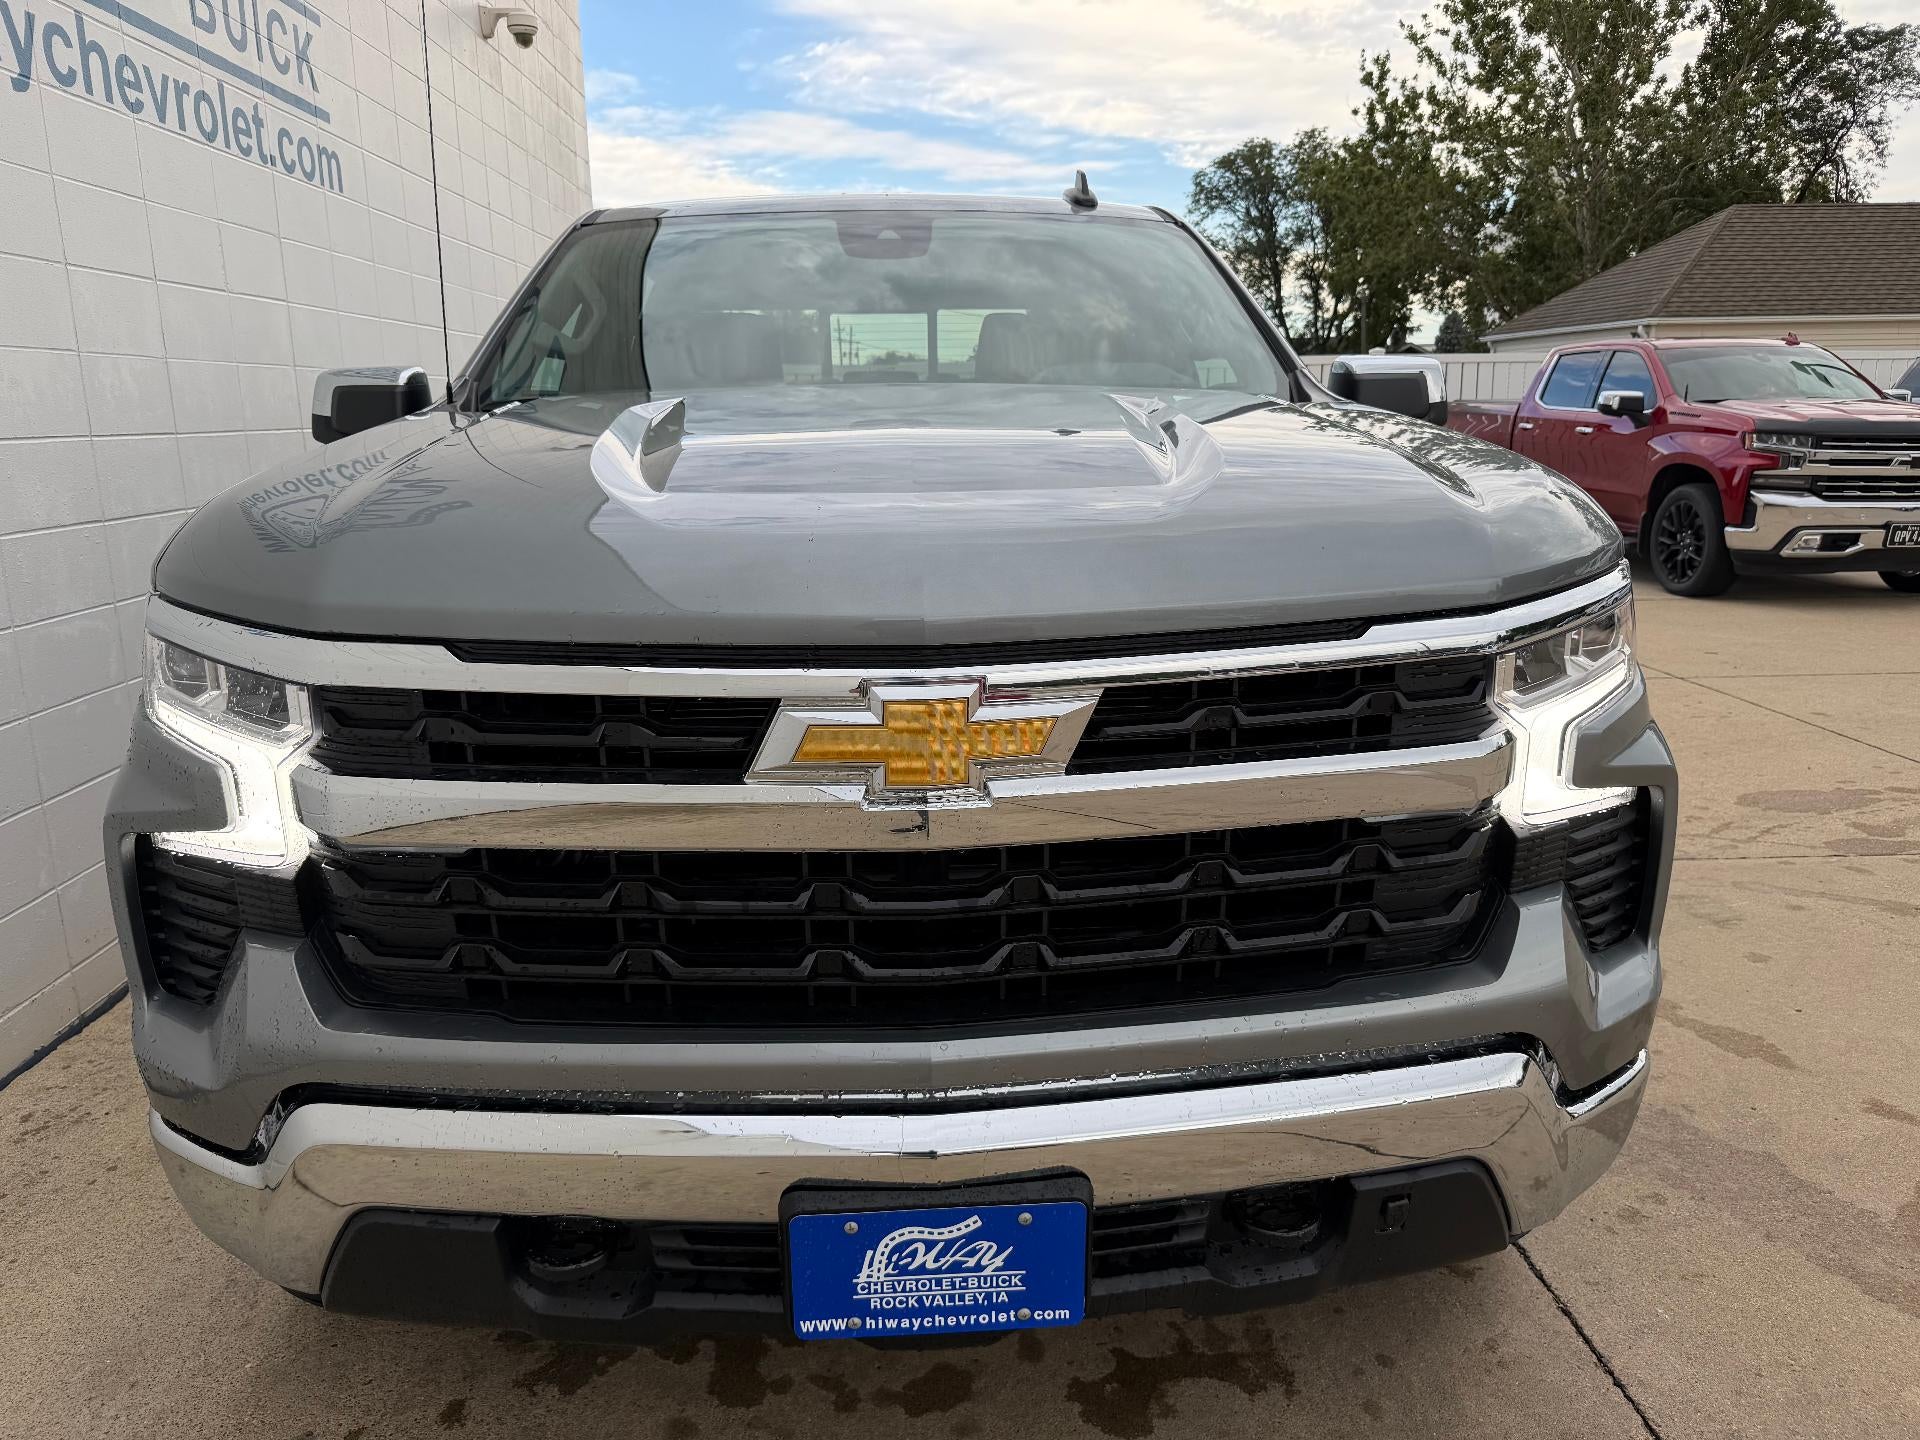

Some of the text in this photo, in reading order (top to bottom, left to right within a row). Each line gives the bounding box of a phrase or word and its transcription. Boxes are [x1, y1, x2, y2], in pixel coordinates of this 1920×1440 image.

[0, 0, 344, 193] ychevrolet.com
[856, 1275, 1023, 1295] CHEVROLET-BUICK
[870, 1291, 1009, 1310] ROCK VALLEY, IA
